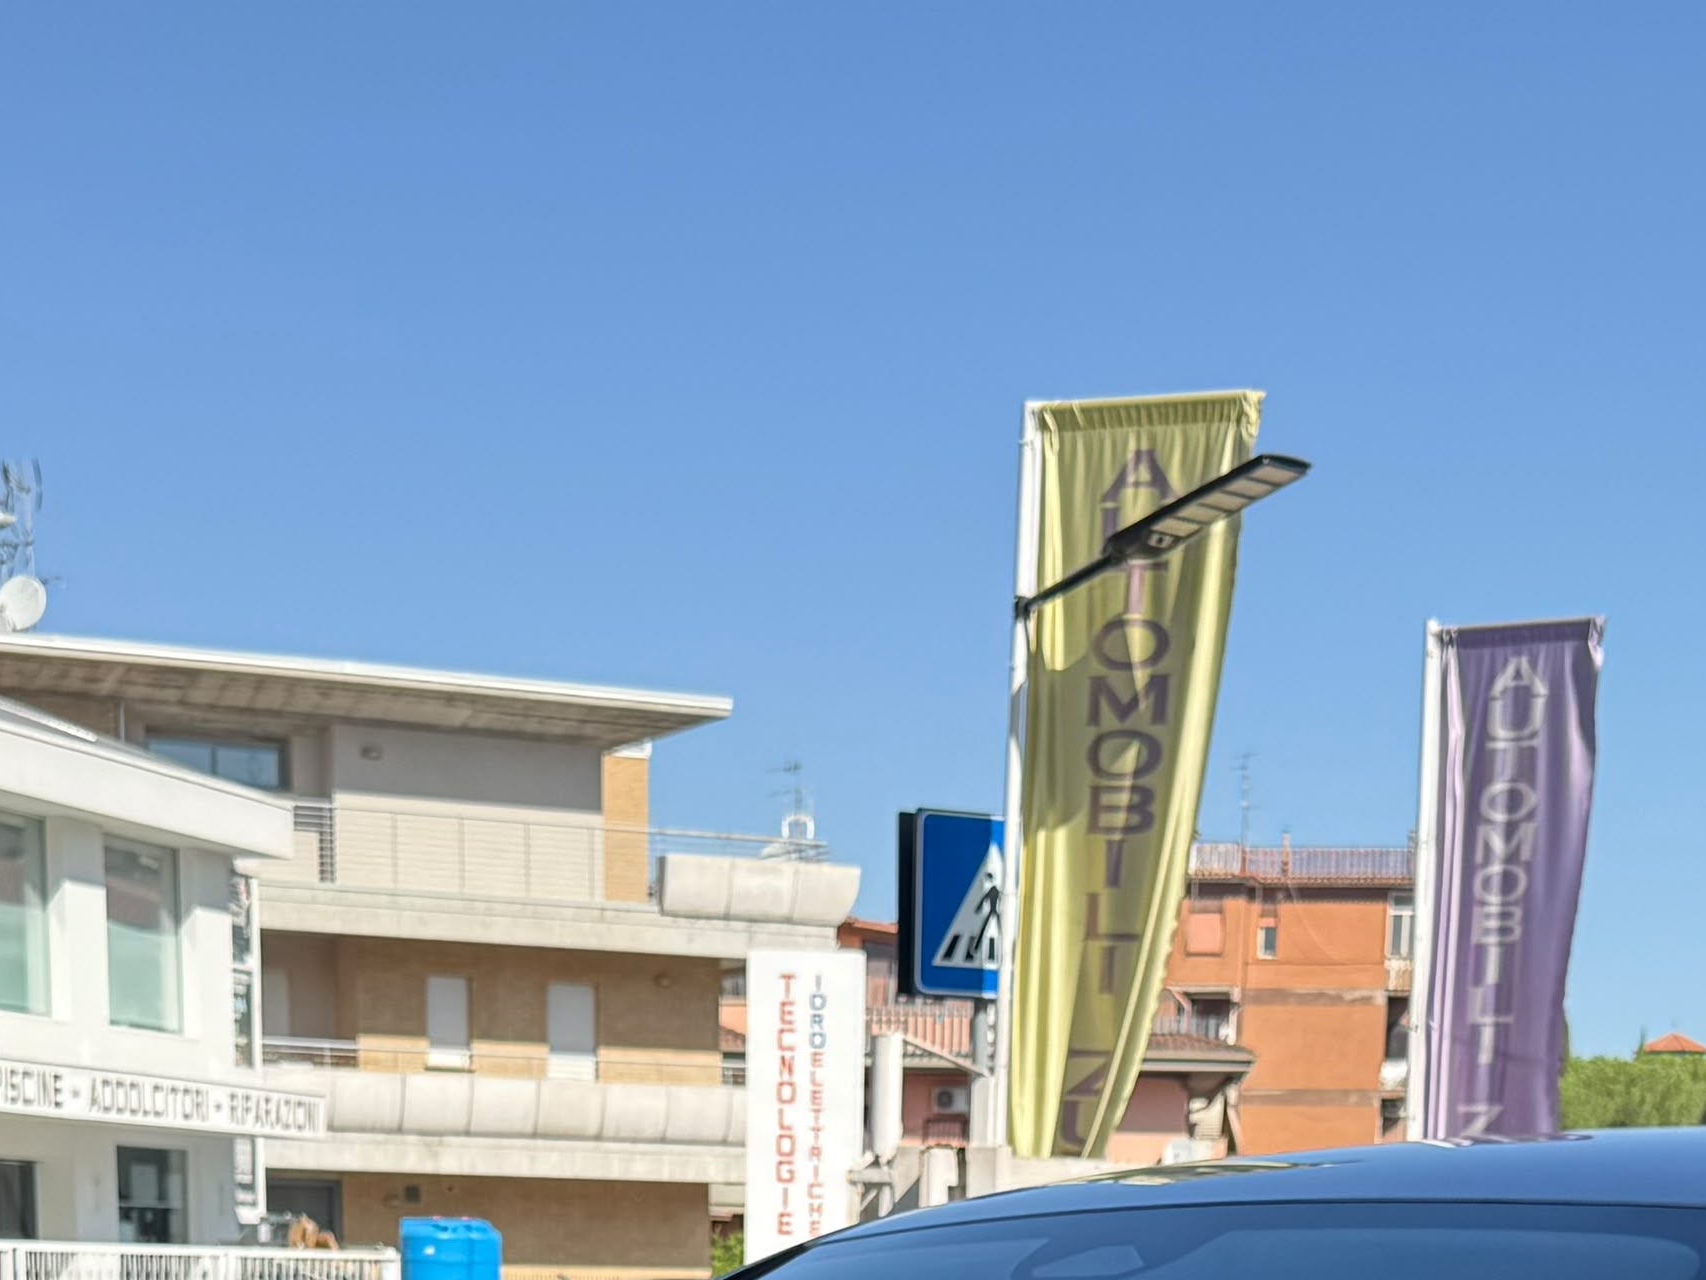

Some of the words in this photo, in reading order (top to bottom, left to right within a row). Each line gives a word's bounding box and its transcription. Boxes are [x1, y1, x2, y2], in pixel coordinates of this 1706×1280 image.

[1467, 656, 1548, 1064] AUTOMOBILI
[89, 1077, 210, 1122] ADDOLCITORI
[776, 973, 797, 1235] TECNOLOGIE
